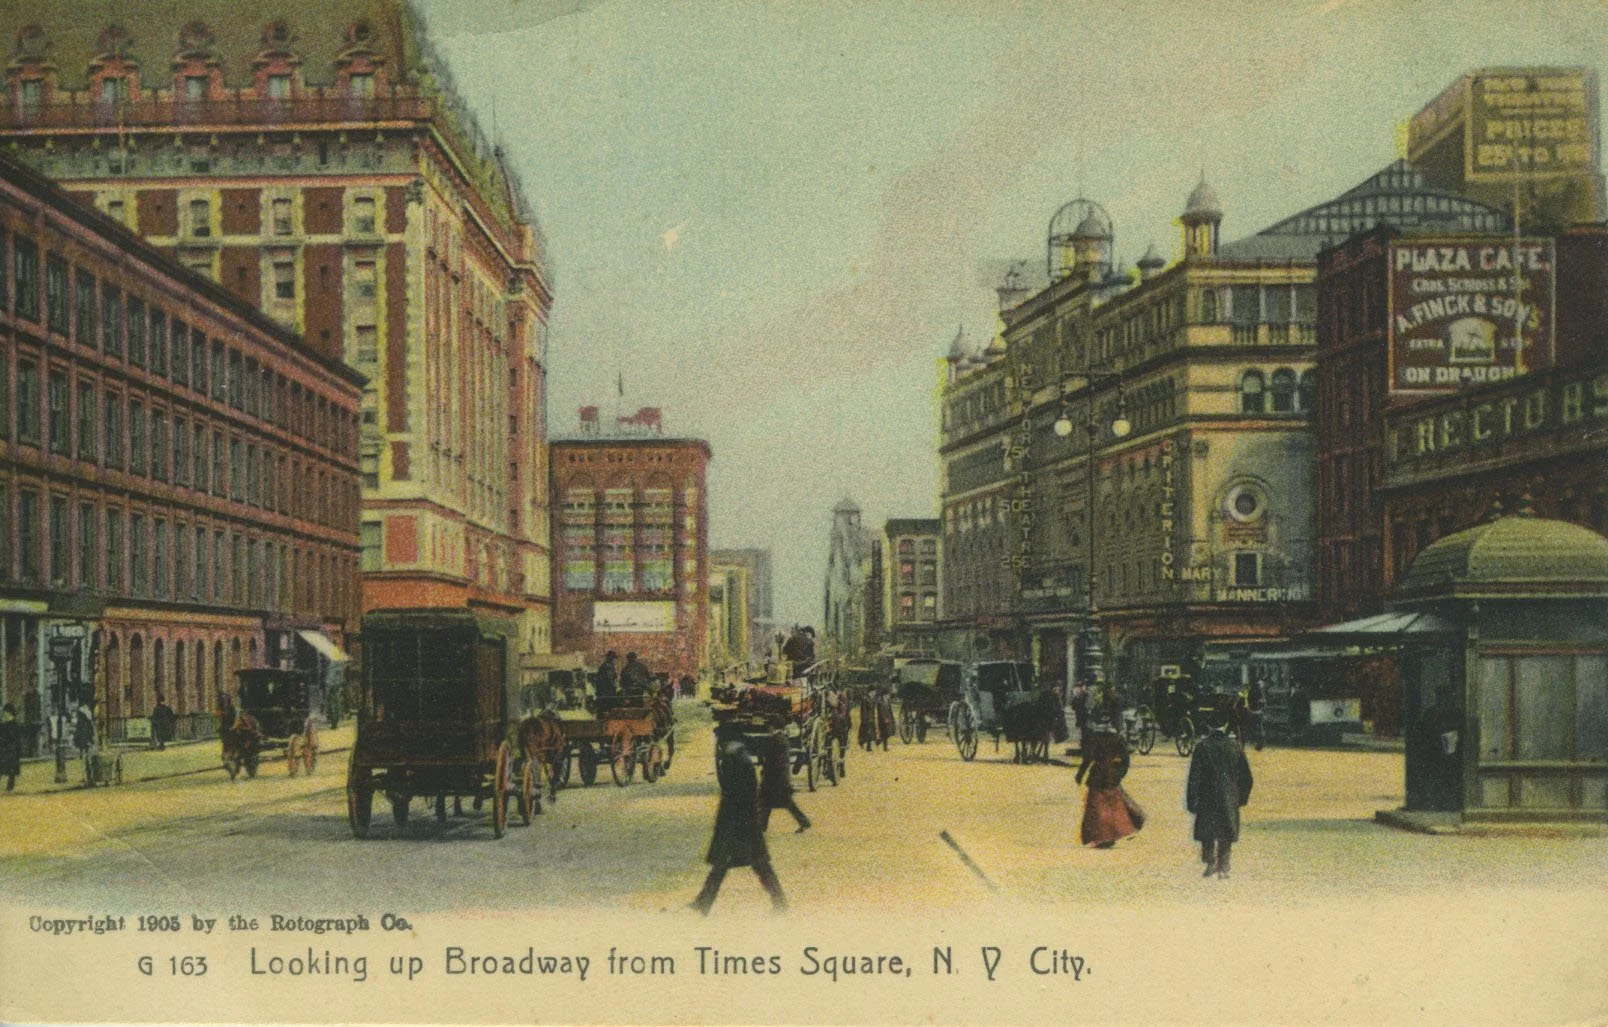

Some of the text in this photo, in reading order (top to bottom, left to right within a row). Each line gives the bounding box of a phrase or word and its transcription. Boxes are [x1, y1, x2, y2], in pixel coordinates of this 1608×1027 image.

[1396, 246, 1472, 272] PLAZA
[1473, 292, 1487, 314] &
[1405, 366, 1431, 383] ON
[1020, 471, 1033, 569] THEATRE
[1160, 438, 1175, 580] CRITERION
[1181, 566, 1223, 580] MARY
